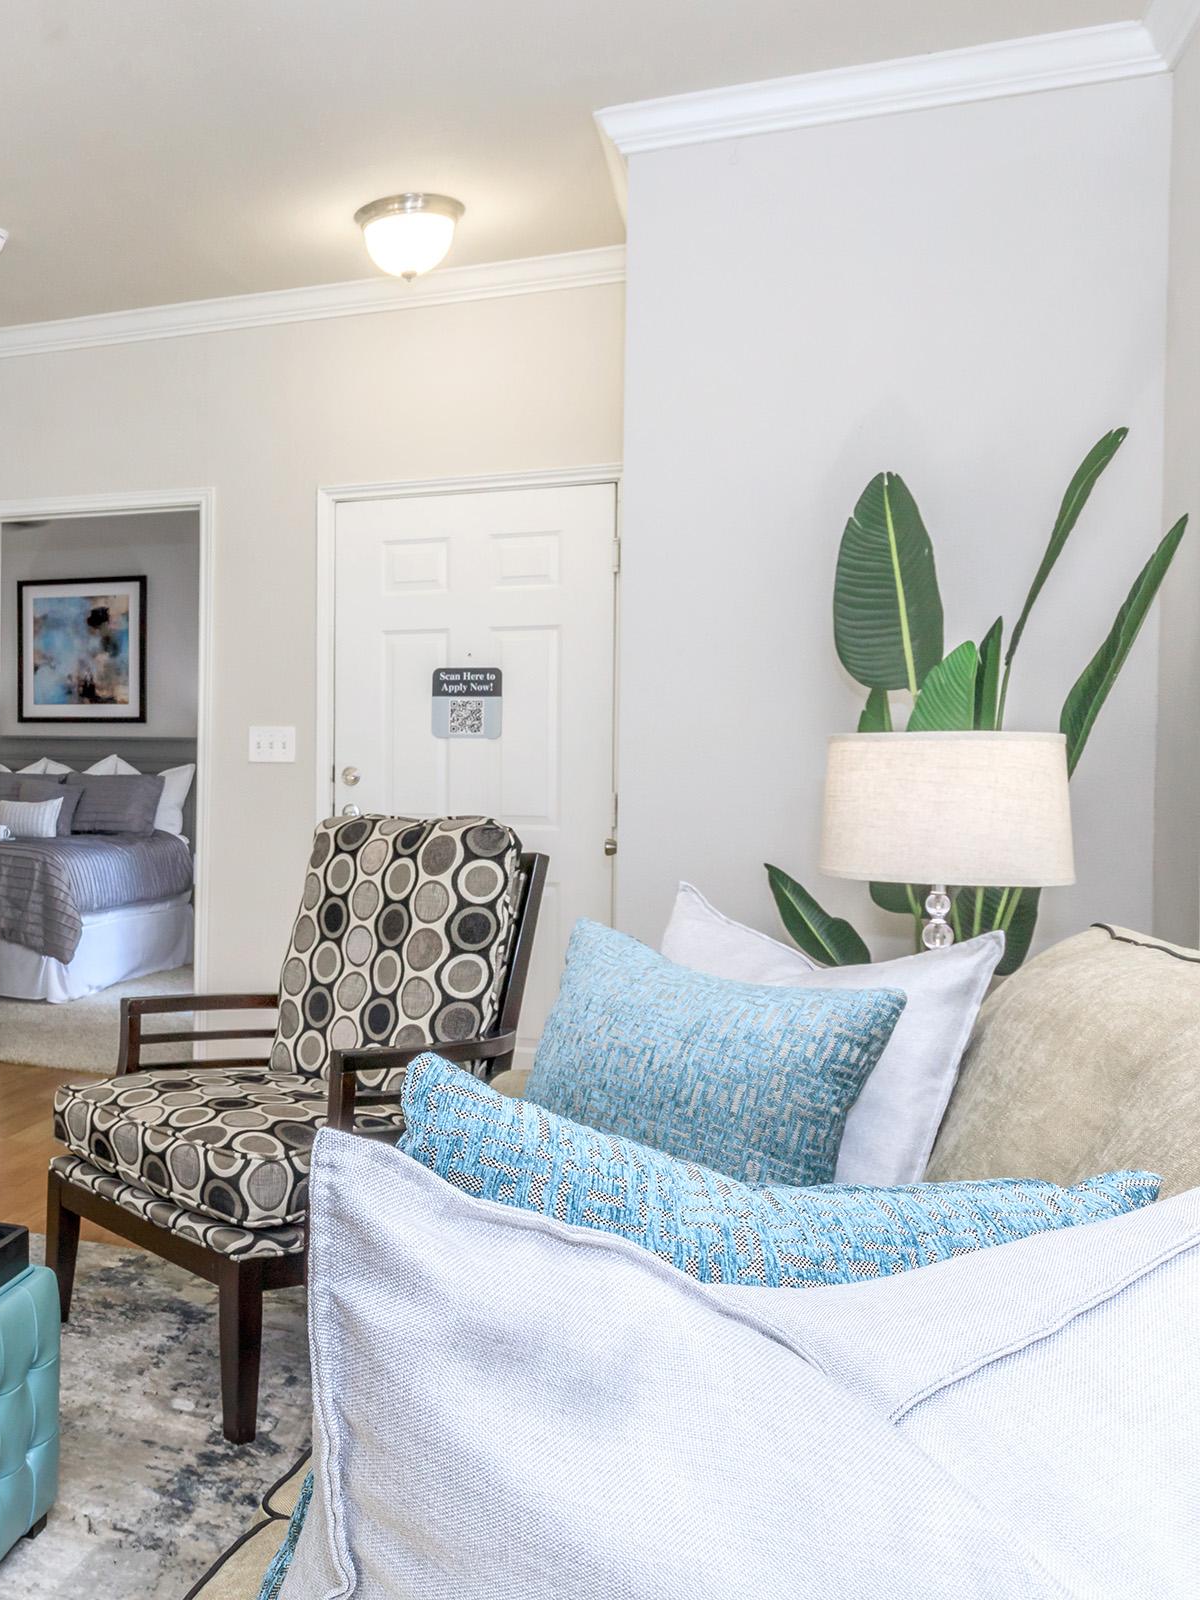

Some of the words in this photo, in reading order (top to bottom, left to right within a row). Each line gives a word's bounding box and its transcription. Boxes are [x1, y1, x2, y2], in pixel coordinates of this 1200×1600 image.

[439, 672, 460, 681] Scan
[463, 672, 485, 681] Here
[486, 672, 496, 681] to
[441, 683, 467, 693] Apply
[470, 683, 493, 692] Now!
